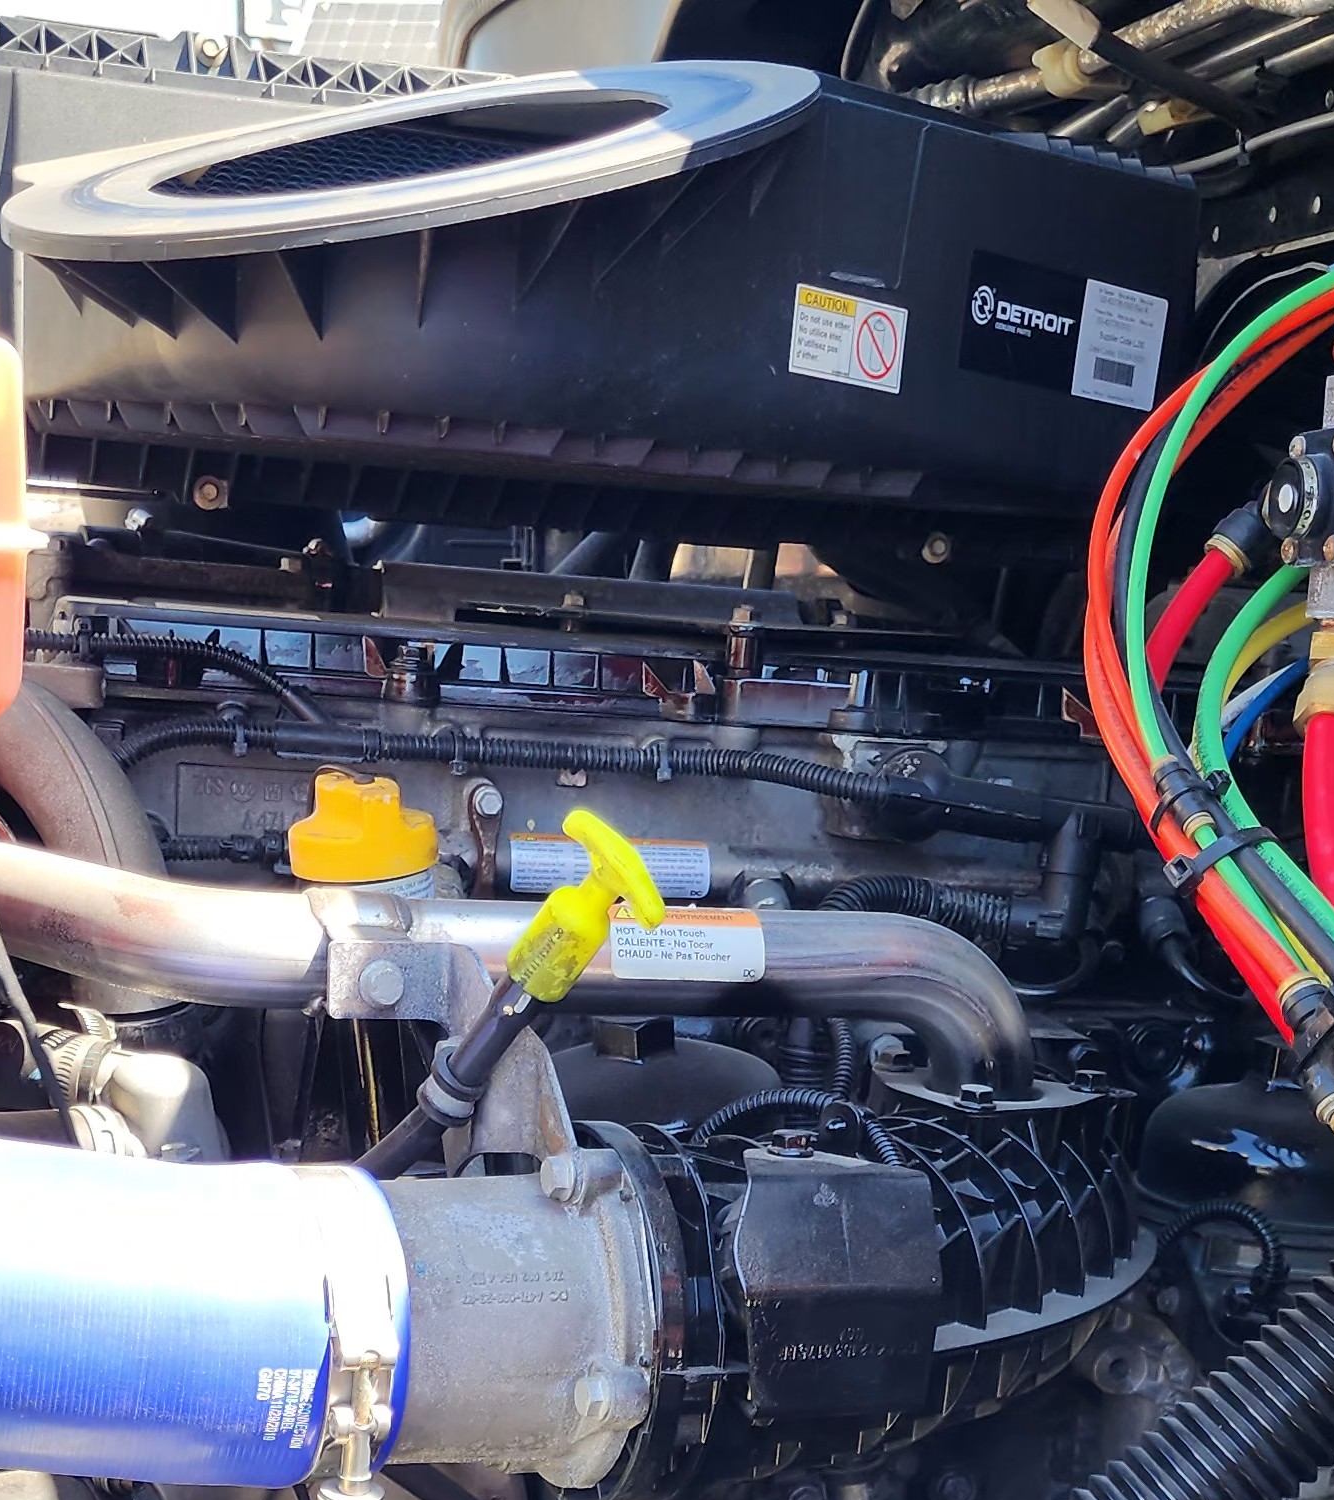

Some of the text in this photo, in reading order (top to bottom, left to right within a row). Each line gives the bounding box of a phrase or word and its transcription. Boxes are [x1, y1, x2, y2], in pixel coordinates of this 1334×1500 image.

[805, 292, 848, 313] CAUTION
[799, 312, 808, 321] Do
[810, 315, 820, 324] not
[996, 300, 1076, 336] DETROIT
[666, 913, 733, 921] VERTISSEMENT
[616, 927, 636, 935] HOT
[661, 928, 677, 936] Not
[679, 928, 706, 938] Touch
[617, 937, 665, 947] CALIENTE
[674, 939, 687, 948] No
[689, 939, 714, 949] Tocar
[618, 949, 652, 959] CHAUD
[661, 951, 674, 961] Ne
[676, 952, 693, 961] Pas
[695, 952, 731, 962] Toucher
[743, 969, 755, 978] DC
[262, 1400, 282, 1442] 11/29/2019
[289, 1402, 312, 1450] CONNECTION
